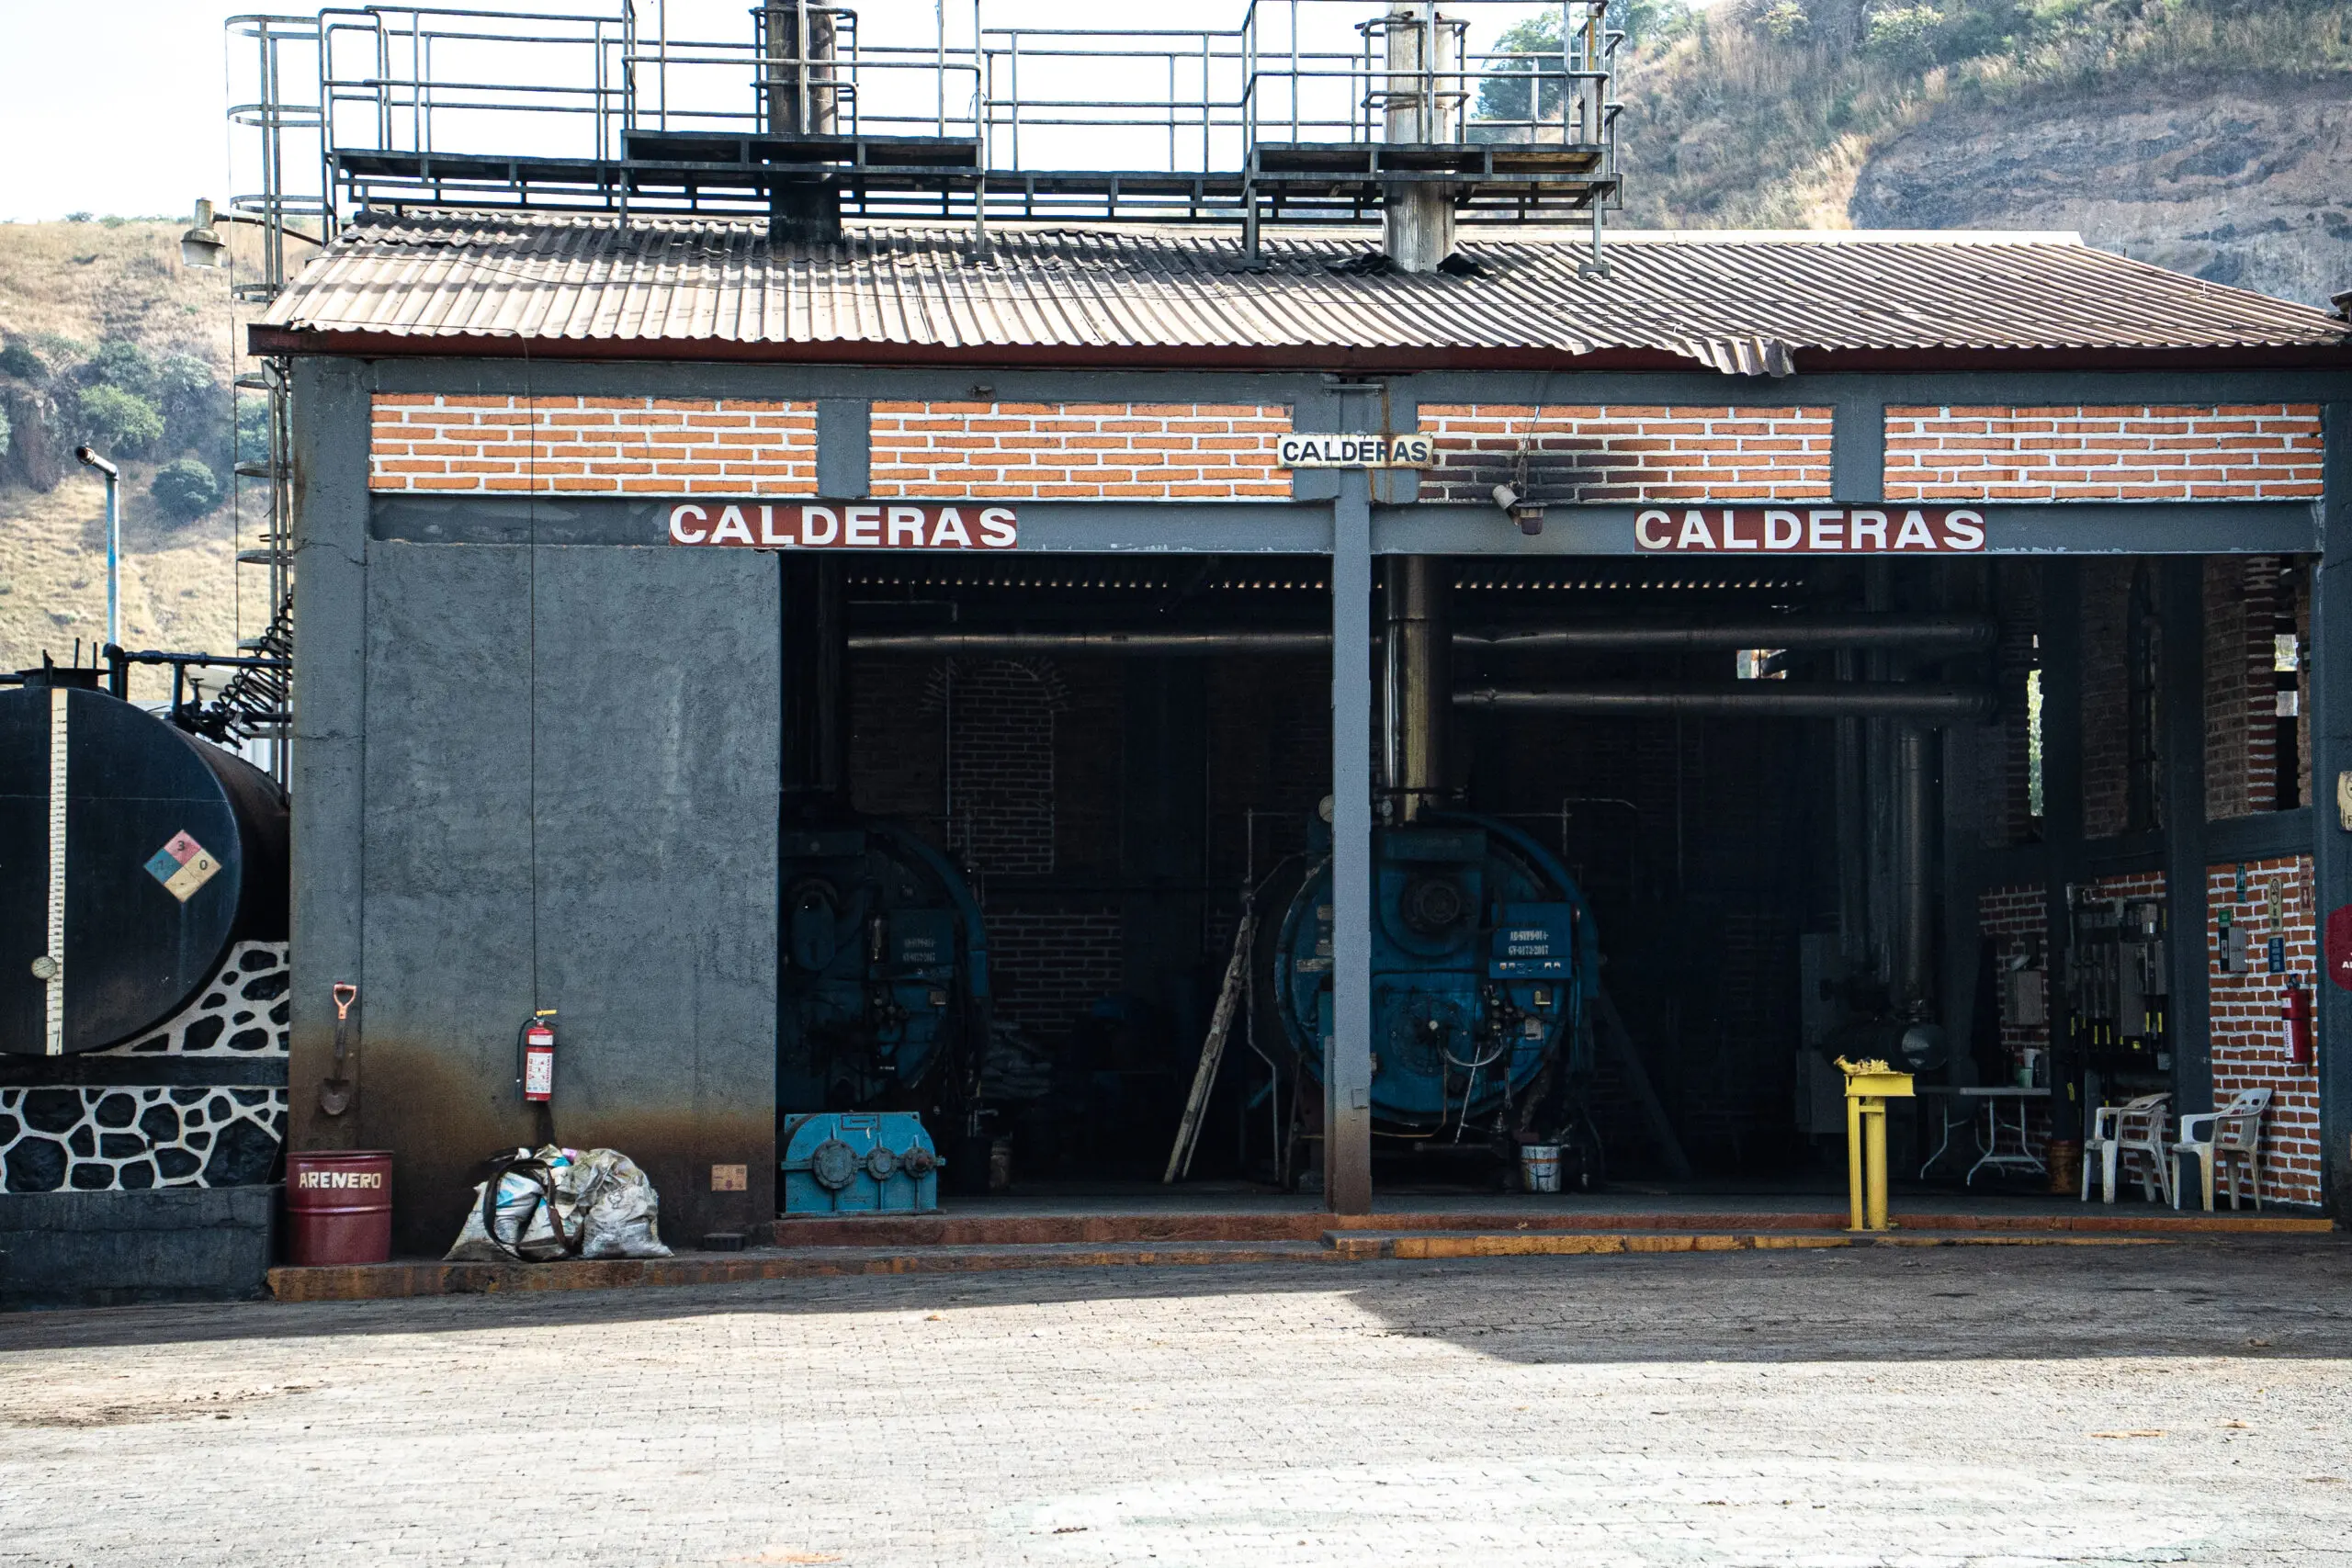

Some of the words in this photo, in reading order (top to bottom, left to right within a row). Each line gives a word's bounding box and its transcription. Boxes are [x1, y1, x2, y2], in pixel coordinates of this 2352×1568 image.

[1283, 441, 1428, 462] CALDERAS
[669, 504, 1017, 548] CALDERAS
[1635, 509, 1984, 550] CALDERAS
[177, 840, 185, 852] 3
[199, 860, 208, 870] 0
[299, 1171, 381, 1189] ARENERO
